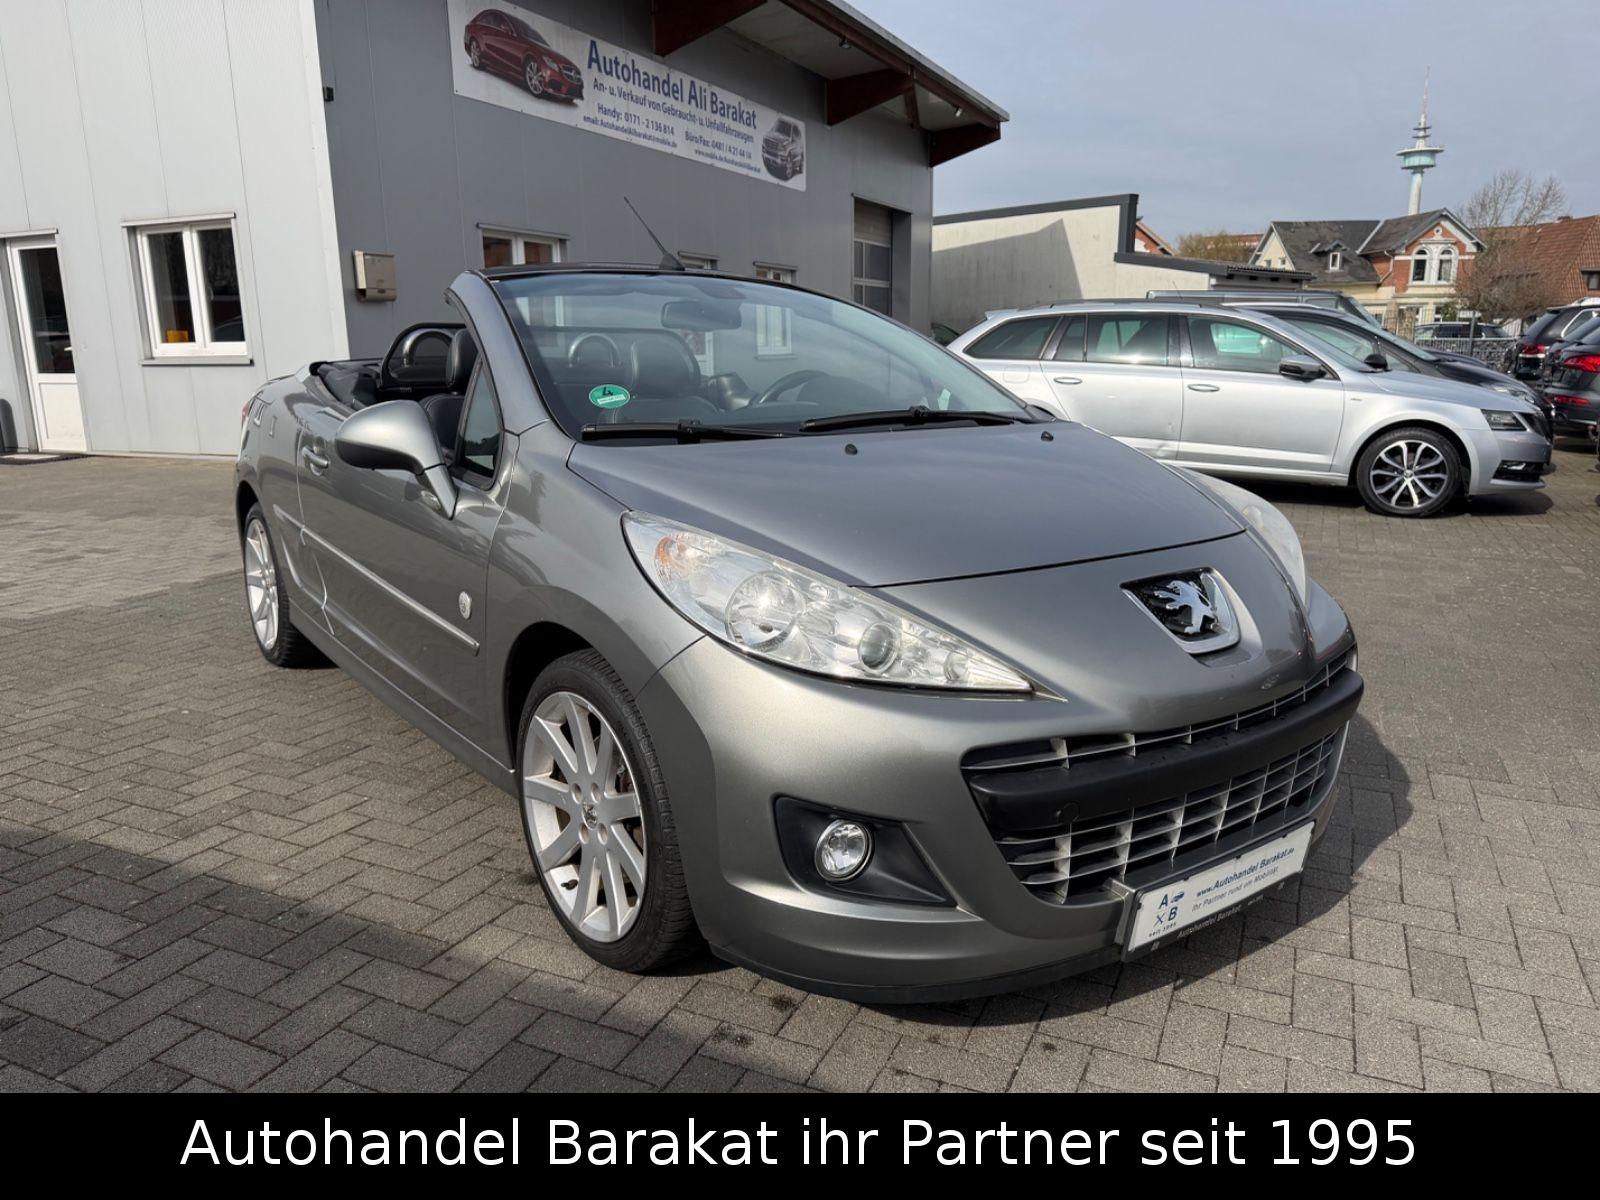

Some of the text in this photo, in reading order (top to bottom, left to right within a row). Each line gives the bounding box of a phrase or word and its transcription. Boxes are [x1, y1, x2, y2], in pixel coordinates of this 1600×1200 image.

[587, 39, 757, 130] Autohandel Ali Barakat
[593, 77, 607, 93] An-
[609, 85, 617, 97] u.
[617, 85, 647, 107] Verkauf
[647, 99, 661, 113] von
[661, 101, 698, 124] Gebraucht-
[705, 117, 755, 144] Unfallfahrzeugen
[597, 102, 623, 122] Handy:
[624, 111, 641, 126] 0171
[1158, 893, 1169, 910] A
[1203, 891, 1228, 907] Partner
[1167, 906, 1178, 922] B
